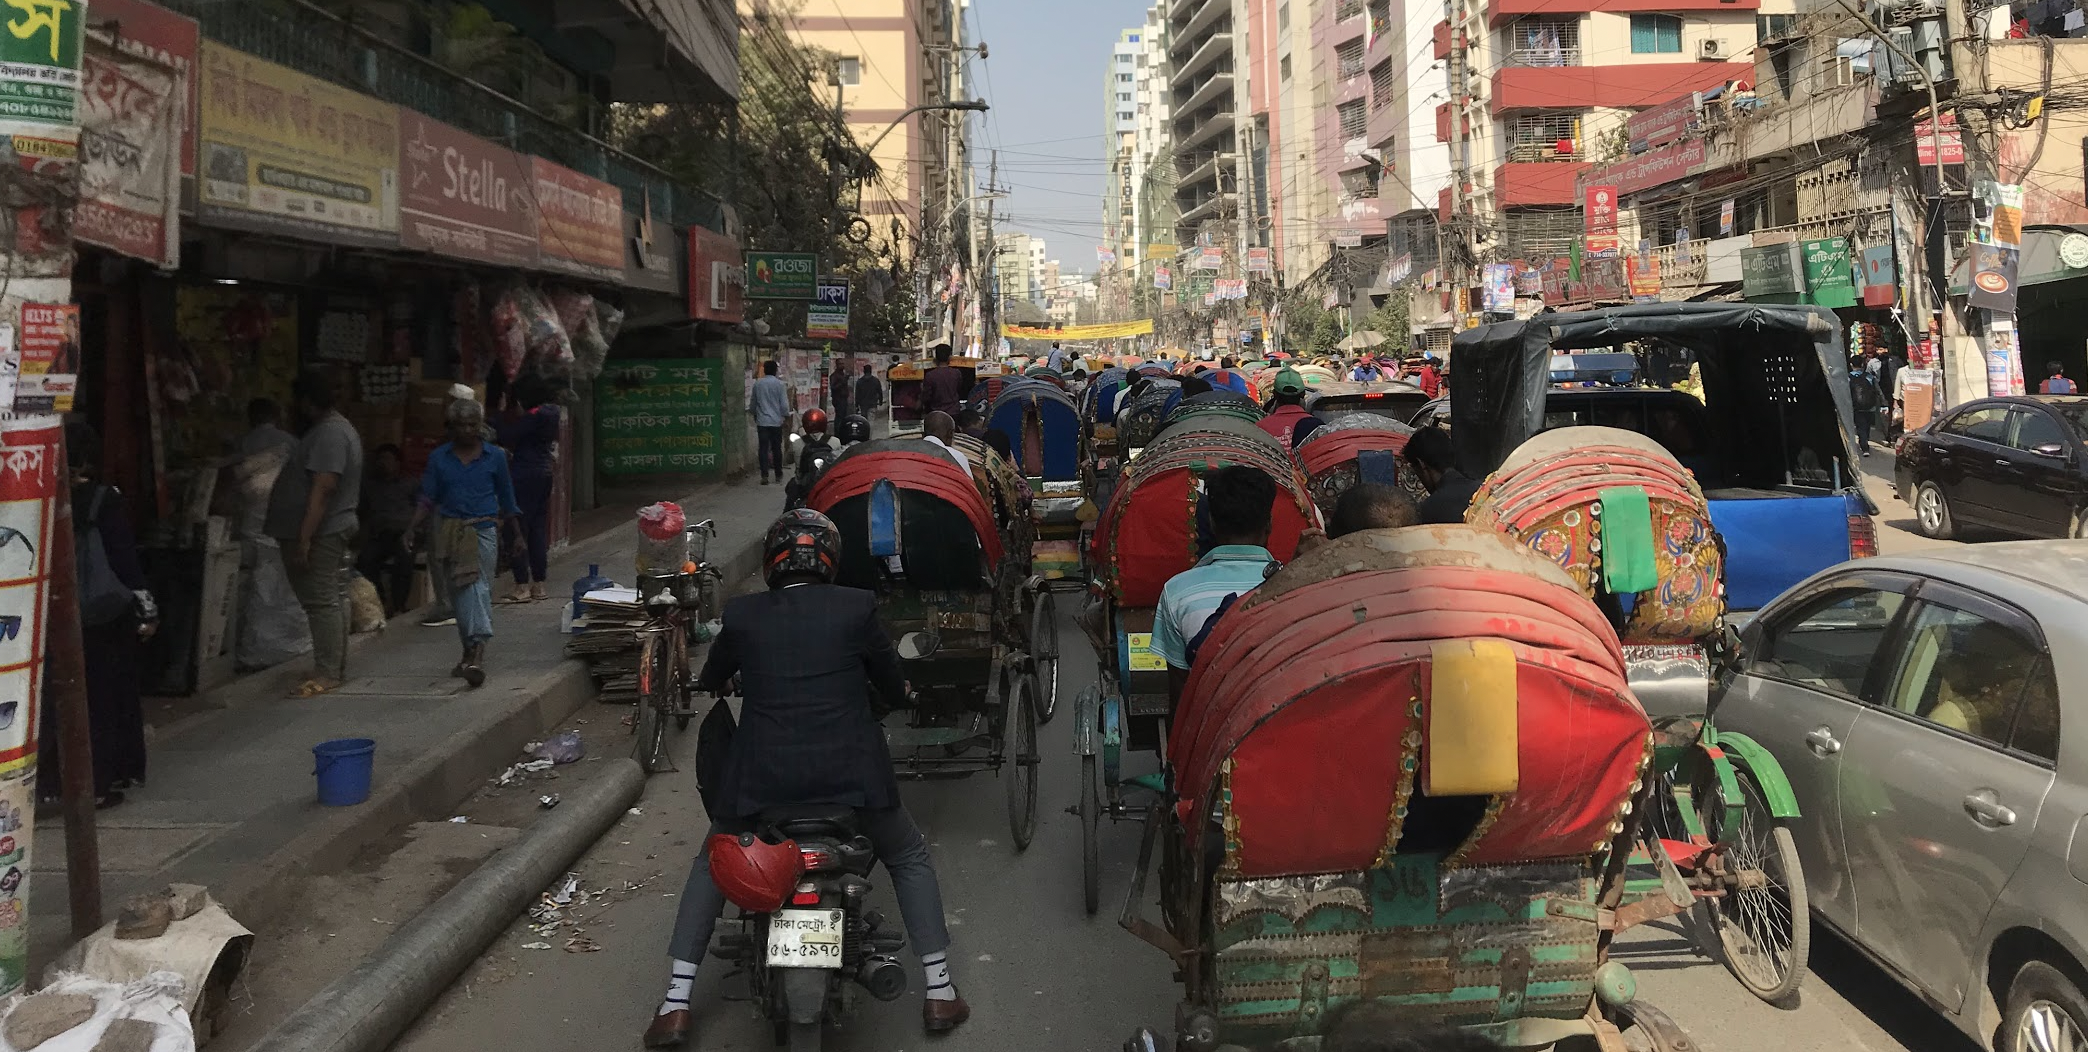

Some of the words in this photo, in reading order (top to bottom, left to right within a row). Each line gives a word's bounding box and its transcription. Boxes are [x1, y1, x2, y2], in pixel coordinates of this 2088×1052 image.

[443, 146, 508, 212] Stella
[1750, 252, 1780, 273] এটিএম
[1808, 250, 1845, 263] এটিএম
[773, 259, 812, 273] রওজা
[602, 412, 673, 429] প্রাকৃতিক
[678, 414, 715, 427] খাদ্য
[620, 453, 664, 467] মসলা
[774, 918, 795, 929] ঢাকা
